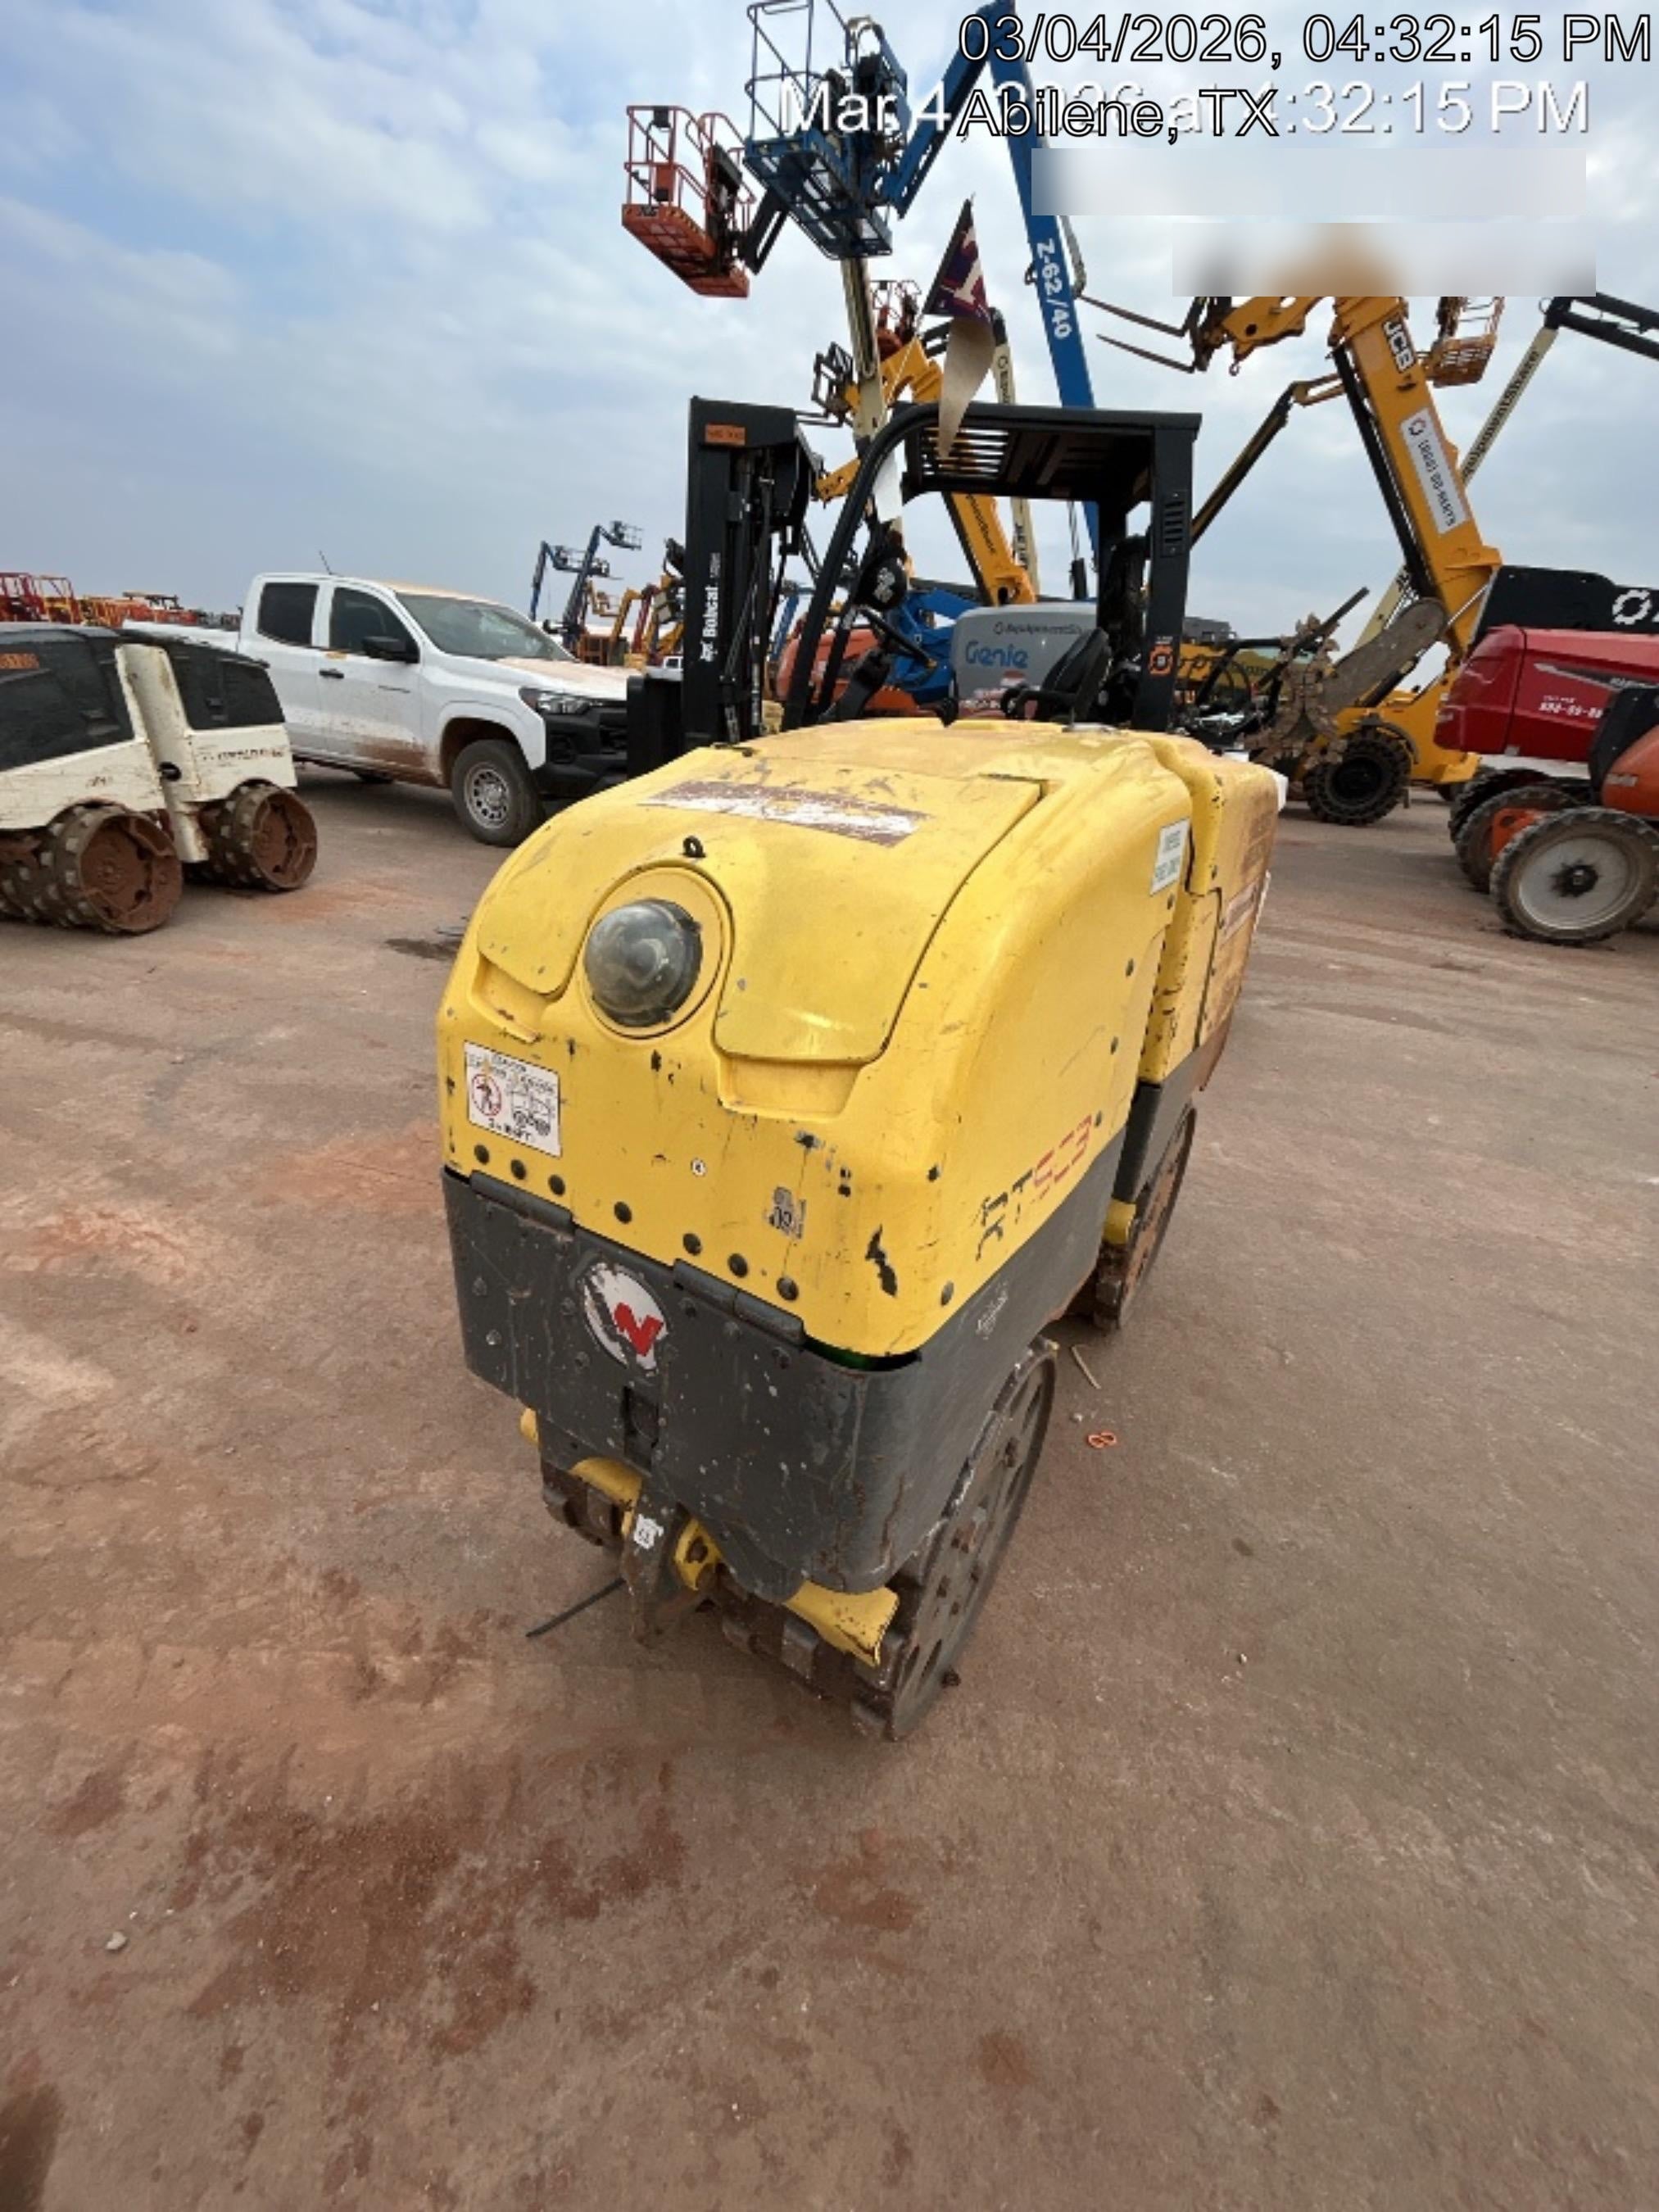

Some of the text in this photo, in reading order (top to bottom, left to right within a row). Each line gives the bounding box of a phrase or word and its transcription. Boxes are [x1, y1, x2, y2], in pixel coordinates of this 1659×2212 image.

[1384, 320, 1414, 372] JCB
[702, 585, 719, 637] Bobcat
[966, 639, 1029, 669] Genie
